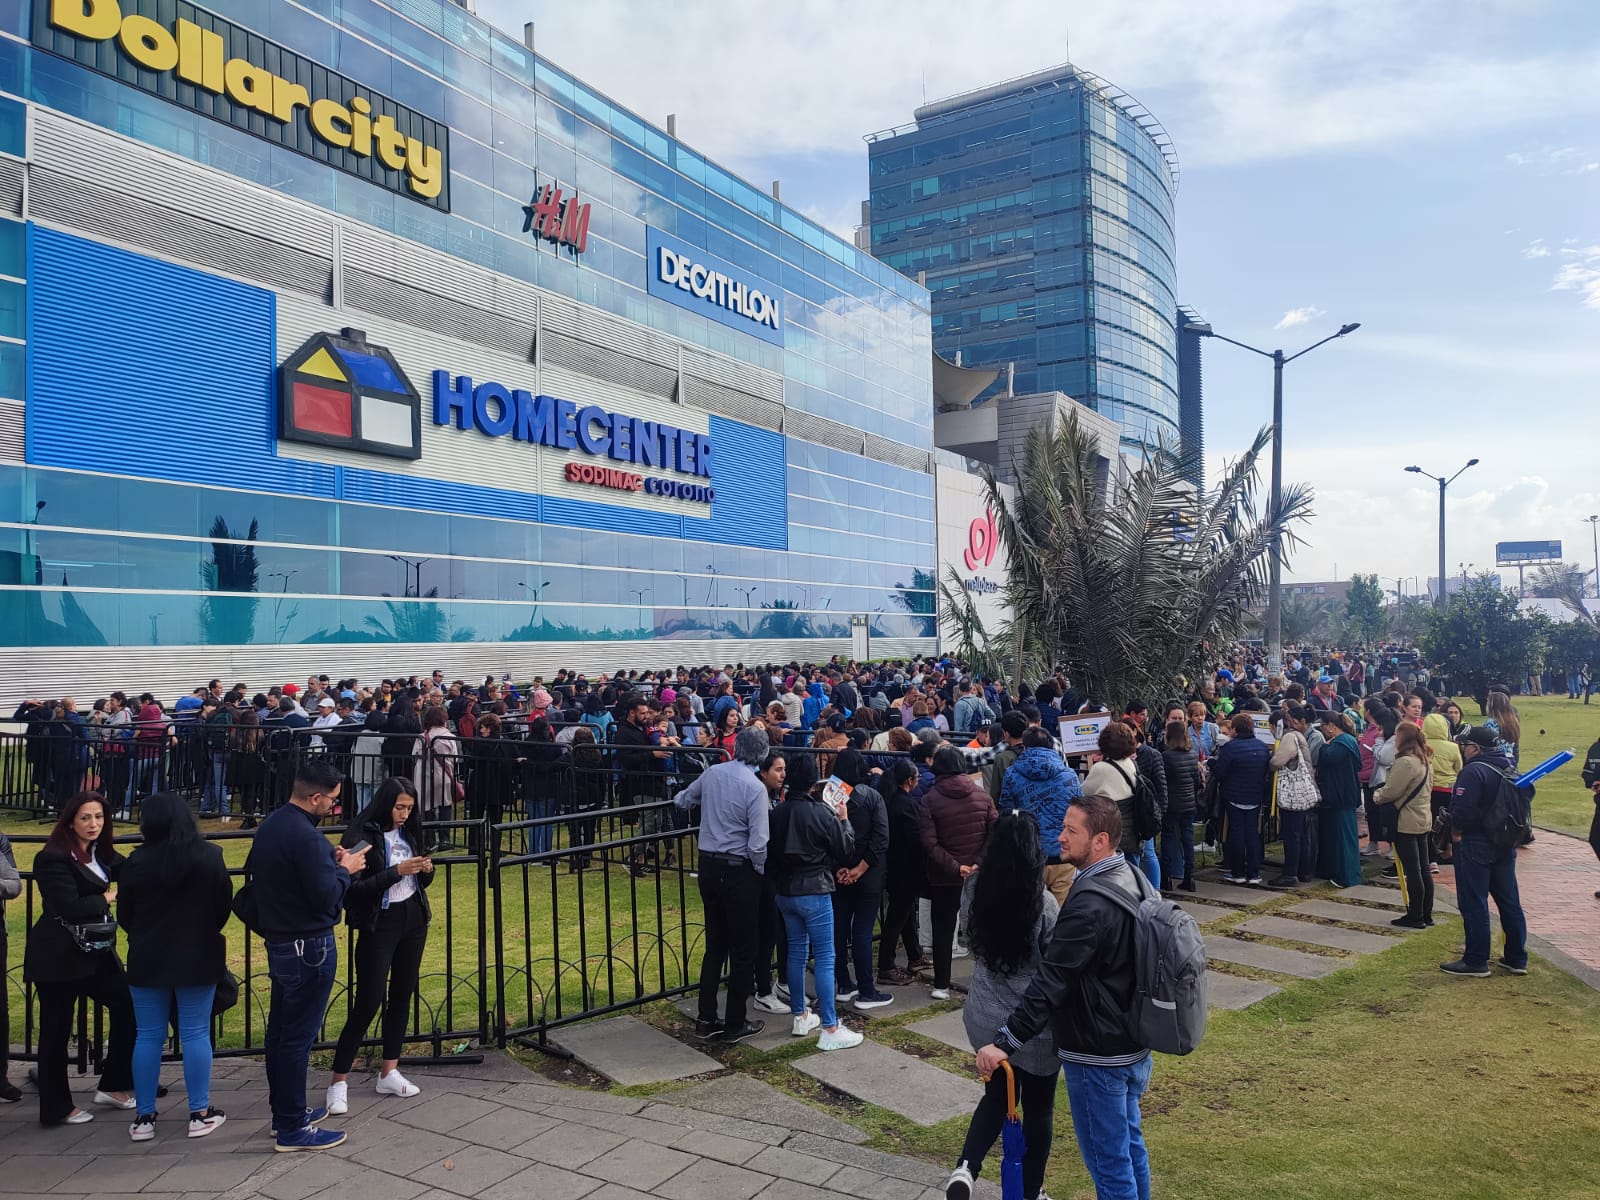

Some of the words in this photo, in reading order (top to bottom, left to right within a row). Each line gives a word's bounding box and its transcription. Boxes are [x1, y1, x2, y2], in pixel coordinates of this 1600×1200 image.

[531, 184, 591, 253] H&M
[657, 246, 780, 329] DECATHLON
[432, 369, 713, 478] HOMECENTER
[565, 462, 644, 491] SODIMAC
[1075, 725, 1098, 734] IKEA
